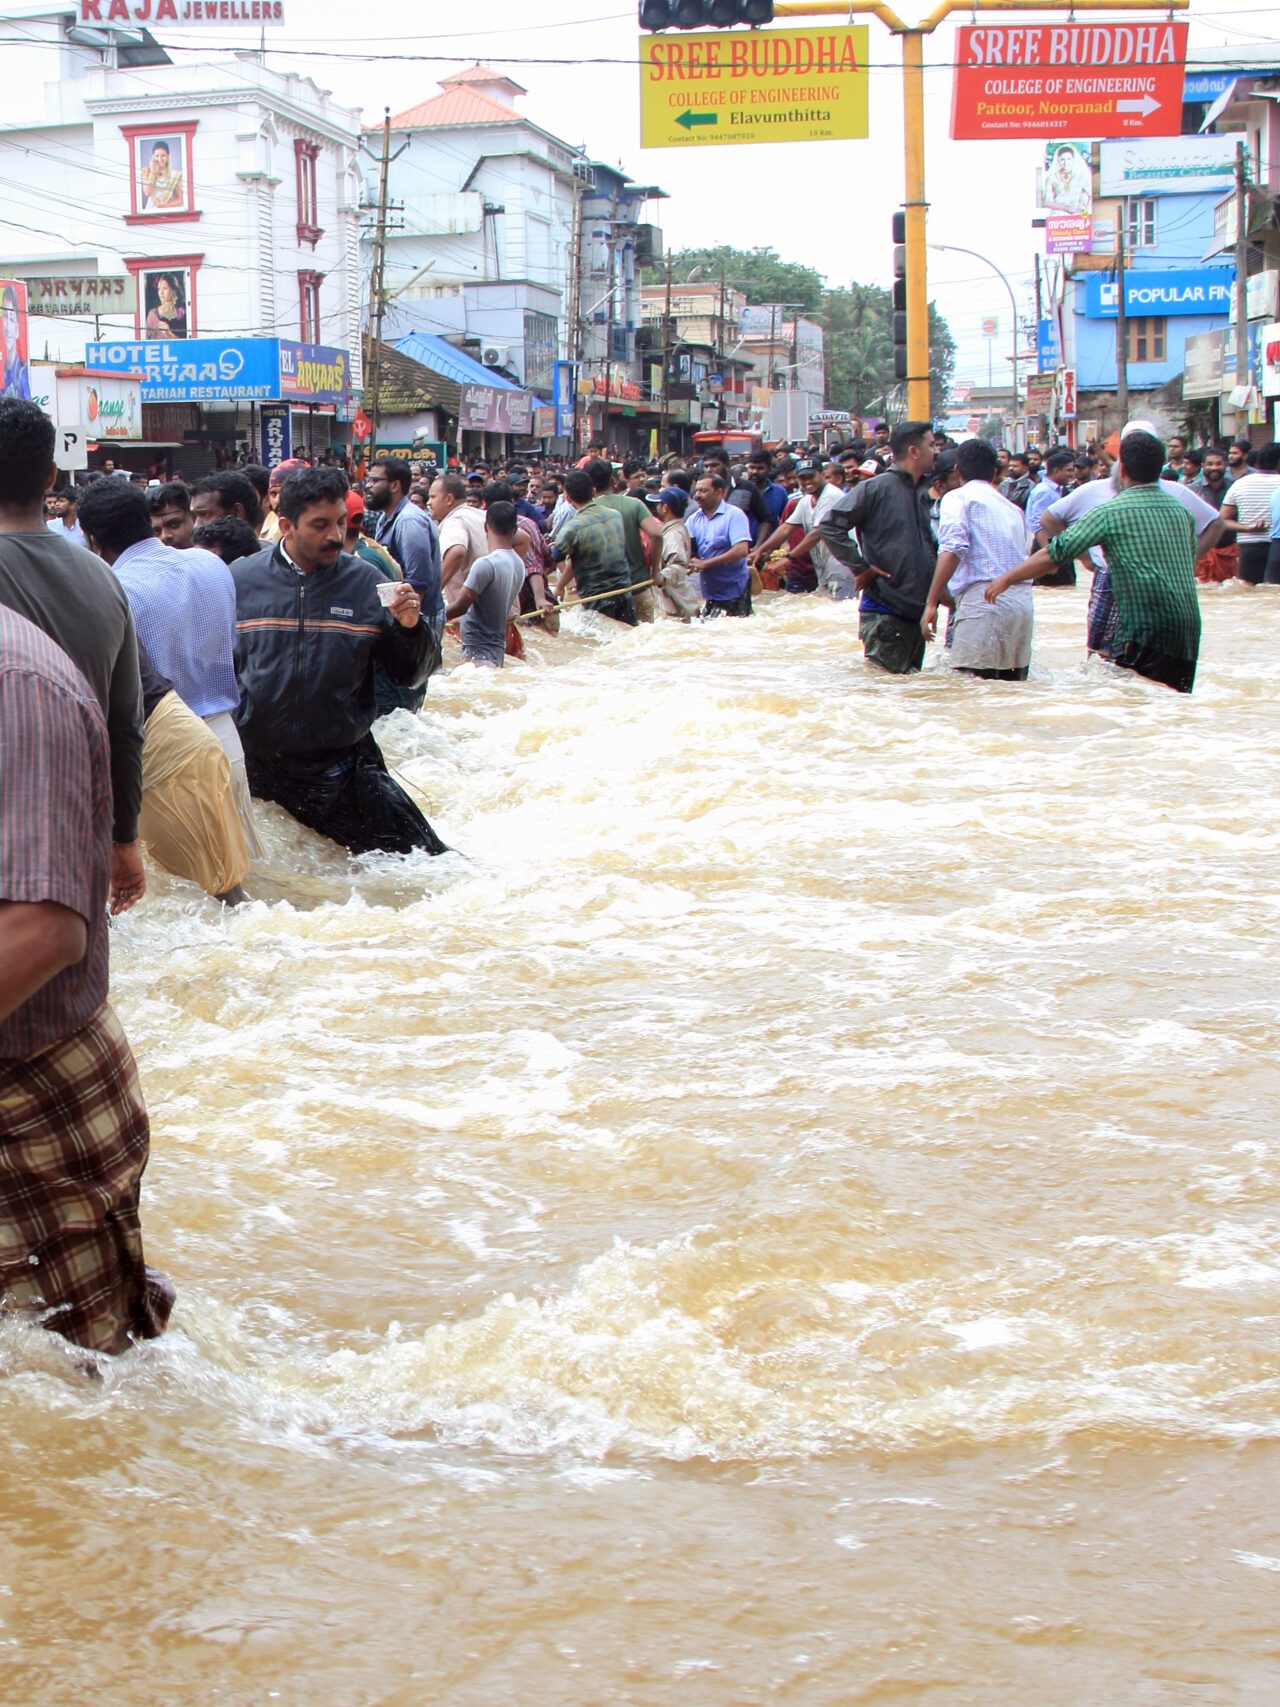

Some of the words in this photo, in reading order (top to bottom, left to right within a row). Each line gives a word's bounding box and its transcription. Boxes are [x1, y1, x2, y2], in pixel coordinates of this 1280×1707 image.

[81, 0, 177, 20] RAJA
[183, 1, 282, 19] JEWELLERS
[968, 29, 1042, 68] SREE
[1050, 27, 1175, 66] BUDDHA
[650, 41, 721, 81] SREE
[730, 35, 858, 77] BUDDHA
[984, 79, 1043, 95] COLLEGE
[1045, 79, 1062, 94] OF
[1065, 77, 1156, 93] ENGINEERING
[668, 90, 726, 107] COLLEGE
[729, 89, 747, 104] OF
[750, 86, 840, 104] ENGINEERING
[730, 108, 831, 125] Elavumthitta
[976, 101, 1035, 116] Pattoor,
[1039, 99, 1113, 114] Nooranad
[981, 121, 1008, 129] Contact
[668, 133, 695, 142] Contact
[1129, 170, 1176, 179] Beauty
[1179, 168, 1211, 177] Care
[40, 279, 125, 297] ARYAAS
[1128, 287, 1205, 304] POPULAR
[88, 345, 178, 364] HOTEL
[128, 355, 241, 382] ARYAAS
[297, 355, 345, 393] ARYAAS
[190, 385, 271, 399] RESTAURANT
[1064, 371, 1075, 414] STAR
[64, 433, 78, 452] P
